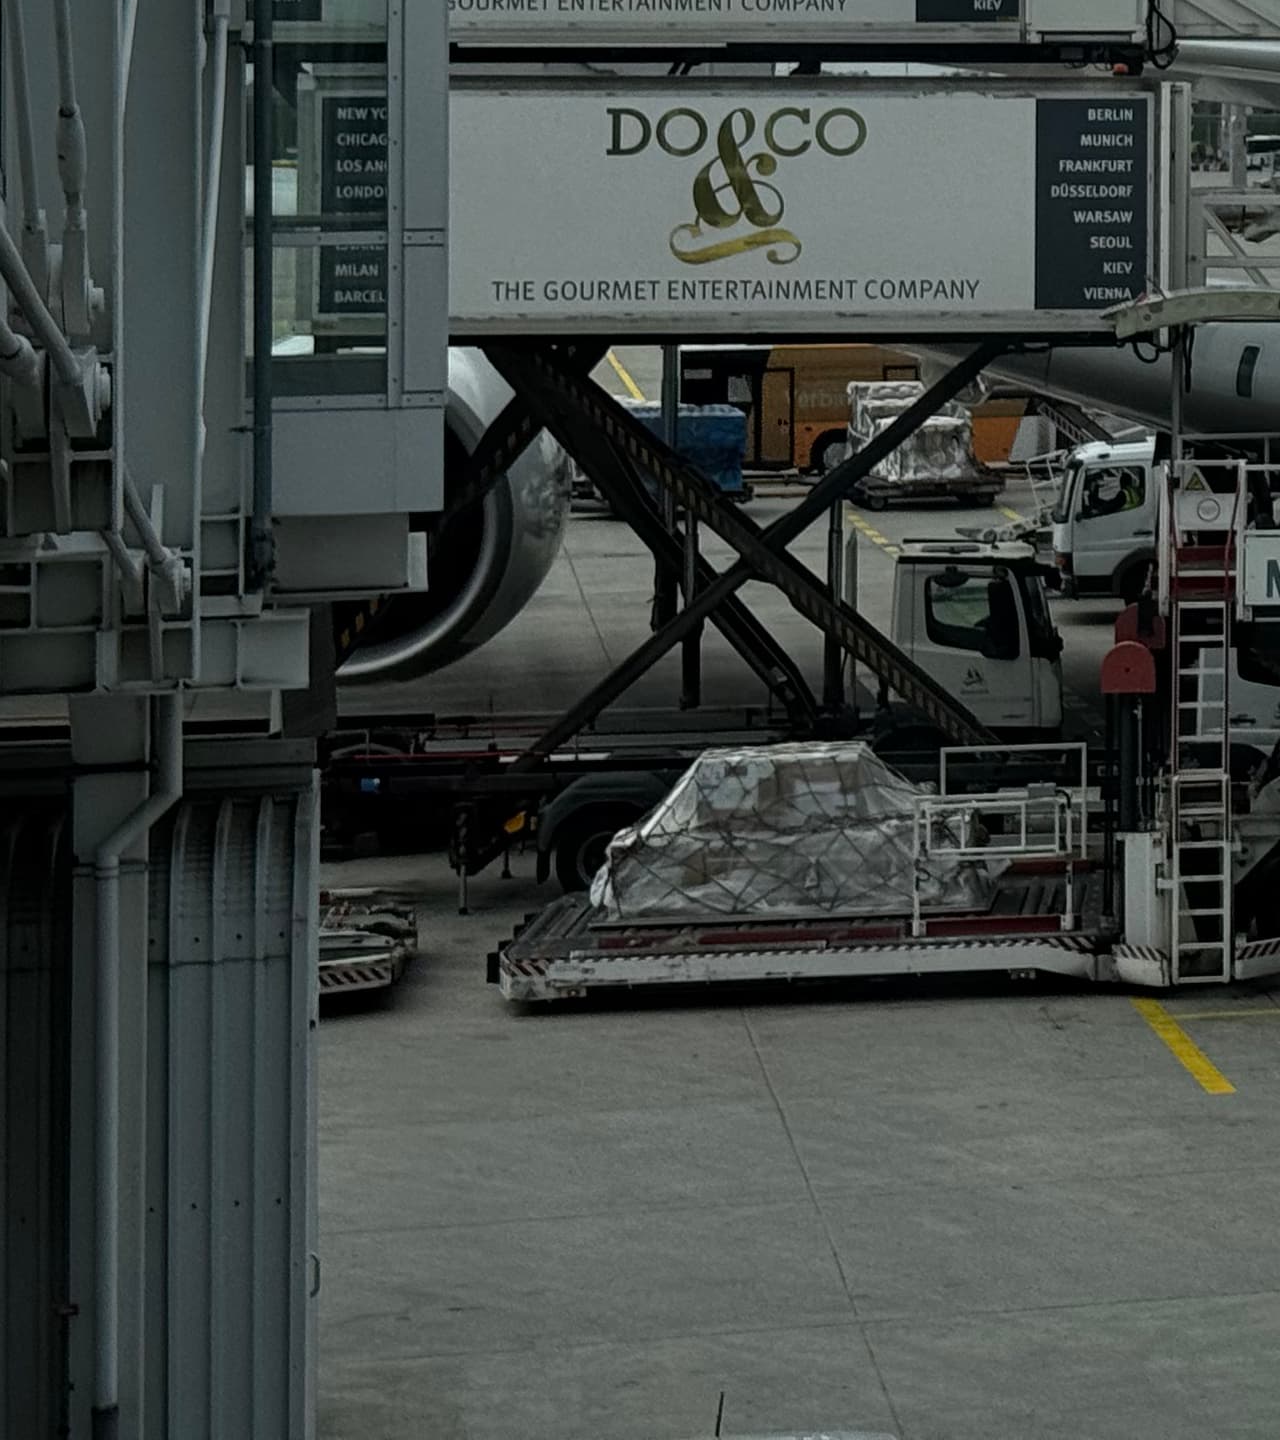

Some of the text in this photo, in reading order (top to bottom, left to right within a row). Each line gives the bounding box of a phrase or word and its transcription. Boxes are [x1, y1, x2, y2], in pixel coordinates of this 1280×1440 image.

[337, 107, 368, 120] NEW
[1087, 108, 1133, 121] BERLIN
[336, 133, 388, 146] CHICAG
[1080, 134, 1133, 147] MUNICH
[337, 160, 362, 172] LOS
[1059, 160, 1133, 172] FRANKFURT
[336, 185, 388, 198] LONDO
[1050, 183, 1134, 198] DÜSSELDORF
[1073, 210, 1134, 223] WARSAW
[1089, 236, 1133, 248] SEOUL
[335, 264, 379, 277] MILAN
[1103, 262, 1133, 274] KIEV
[334, 290, 386, 303] BARCEL
[492, 279, 980, 301] THE GOURMET ENTERTAINMENT COMPANY
[1083, 287, 1133, 301] VIENNA
